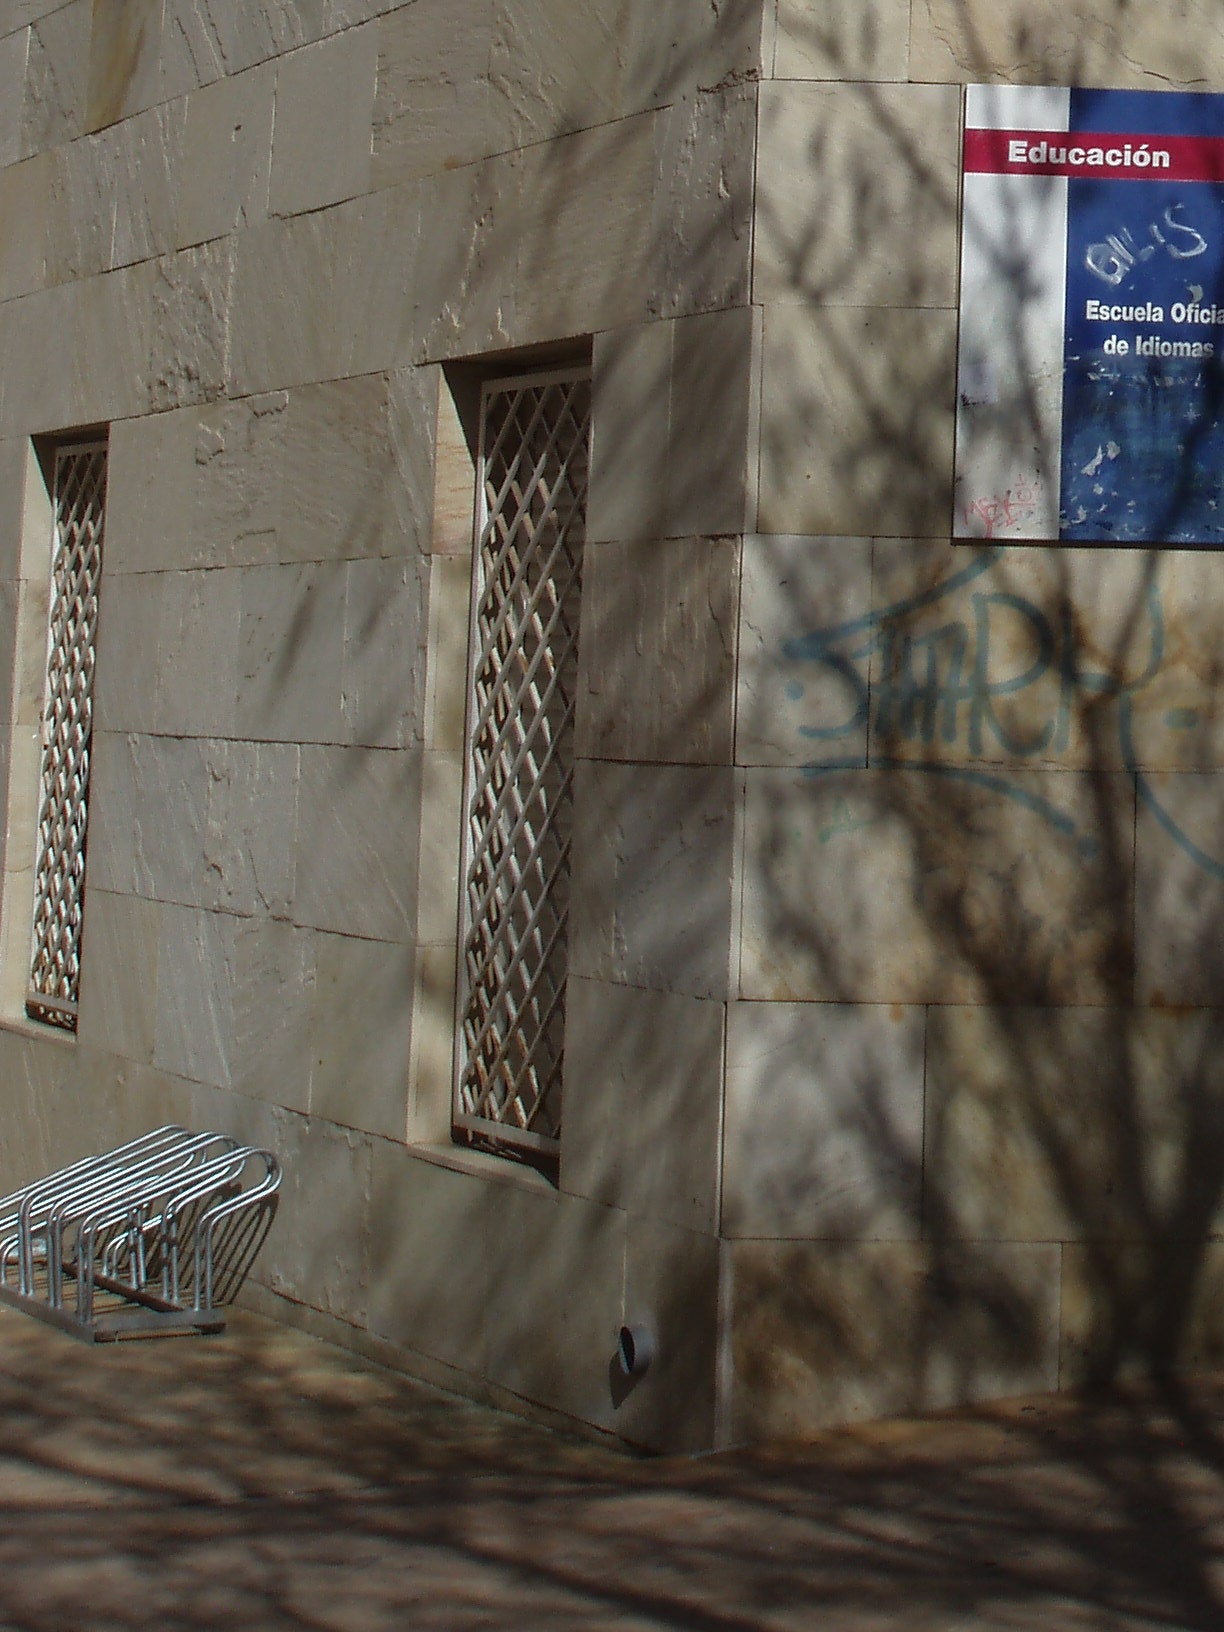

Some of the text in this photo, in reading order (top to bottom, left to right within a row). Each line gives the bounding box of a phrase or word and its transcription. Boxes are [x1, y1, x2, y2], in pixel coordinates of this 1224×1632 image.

[1008, 139, 1170, 168] Educación
[1086, 300, 1163, 322] Escuela
[1104, 335, 1214, 358] de Idiomas
